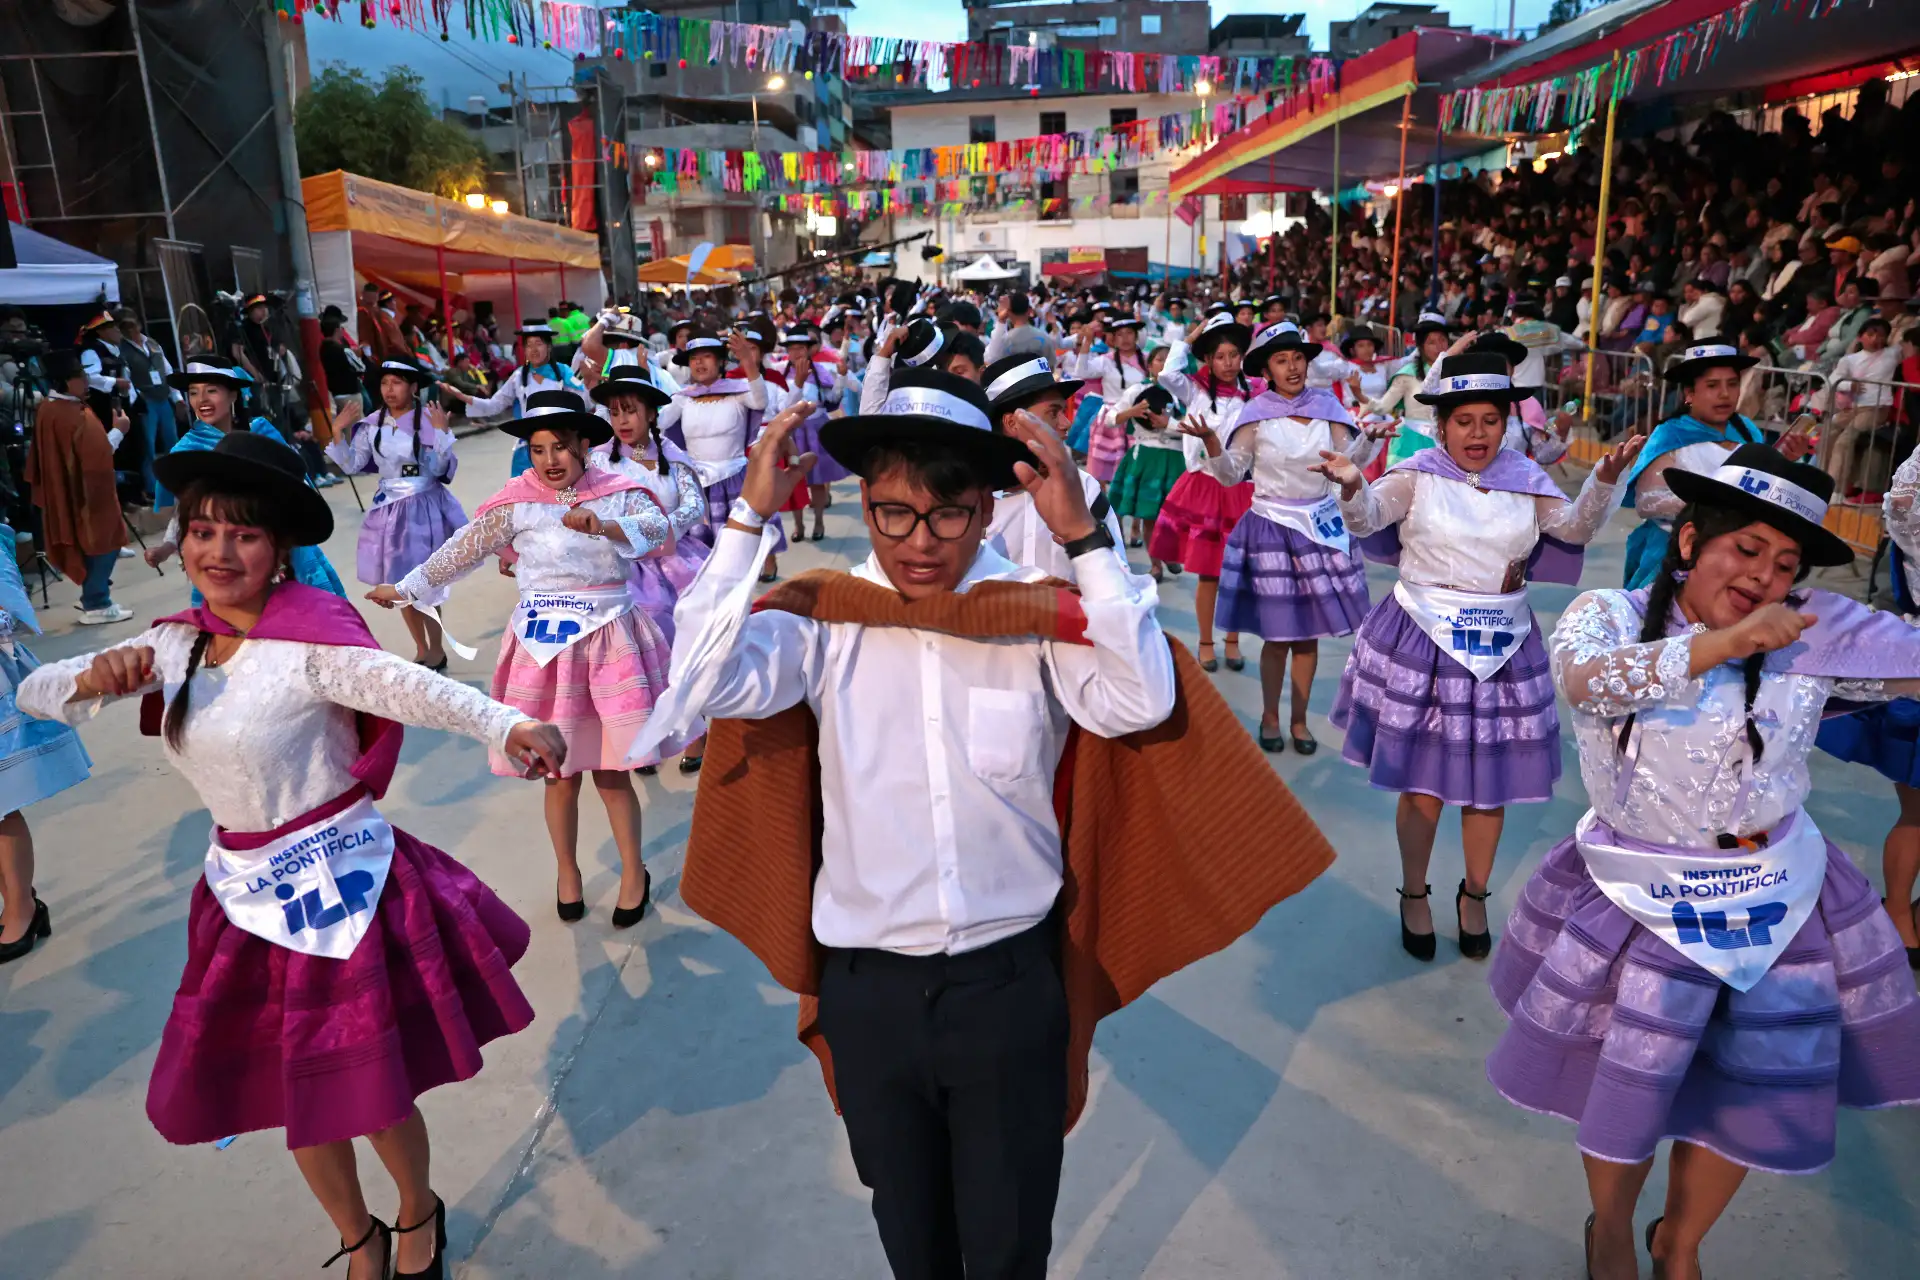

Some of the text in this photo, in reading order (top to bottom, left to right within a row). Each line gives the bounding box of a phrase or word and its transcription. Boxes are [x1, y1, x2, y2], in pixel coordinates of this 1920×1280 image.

[1451, 377, 1469, 390] iLP
[1738, 469, 1770, 495] iLP
[1769, 491, 1782, 503] LA
[1316, 516, 1344, 539] iLP
[520, 599, 594, 612] LA PONTIFICIA
[1459, 607, 1504, 616] INSTITUTO
[524, 609, 581, 644] iLP
[1456, 616, 1515, 627] PONTIFICIA
[269, 826, 339, 867] INSTITUTO
[246, 828, 376, 894] LA PONTIFICIA
[1682, 865, 1763, 881] INSTITUTO
[1650, 869, 1789, 899] LA PONTIFICIA
[274, 869, 375, 936] iLP
[1671, 900, 1789, 950] iLP
